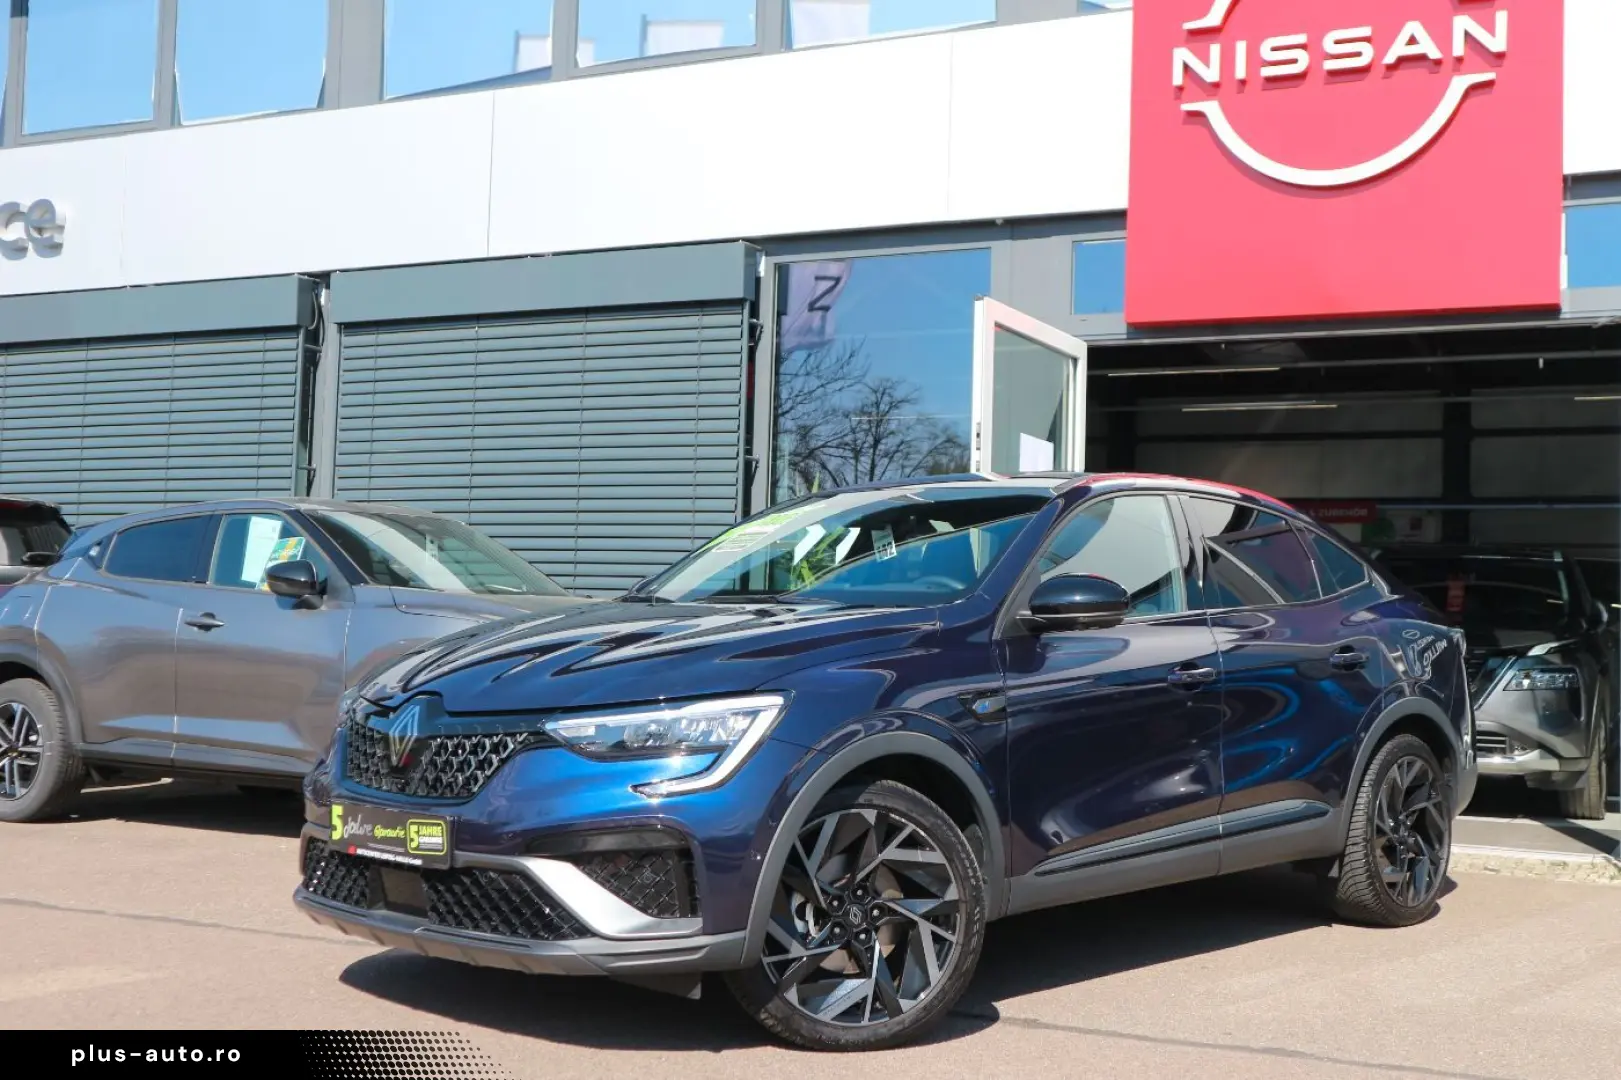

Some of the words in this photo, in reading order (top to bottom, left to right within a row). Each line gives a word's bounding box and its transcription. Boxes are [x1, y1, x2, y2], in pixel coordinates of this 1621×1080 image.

[1172, 10, 1508, 86] NISSAN
[331, 804, 344, 840] 5
[409, 824, 419, 848] 5
[419, 825, 442, 836] JAHRE
